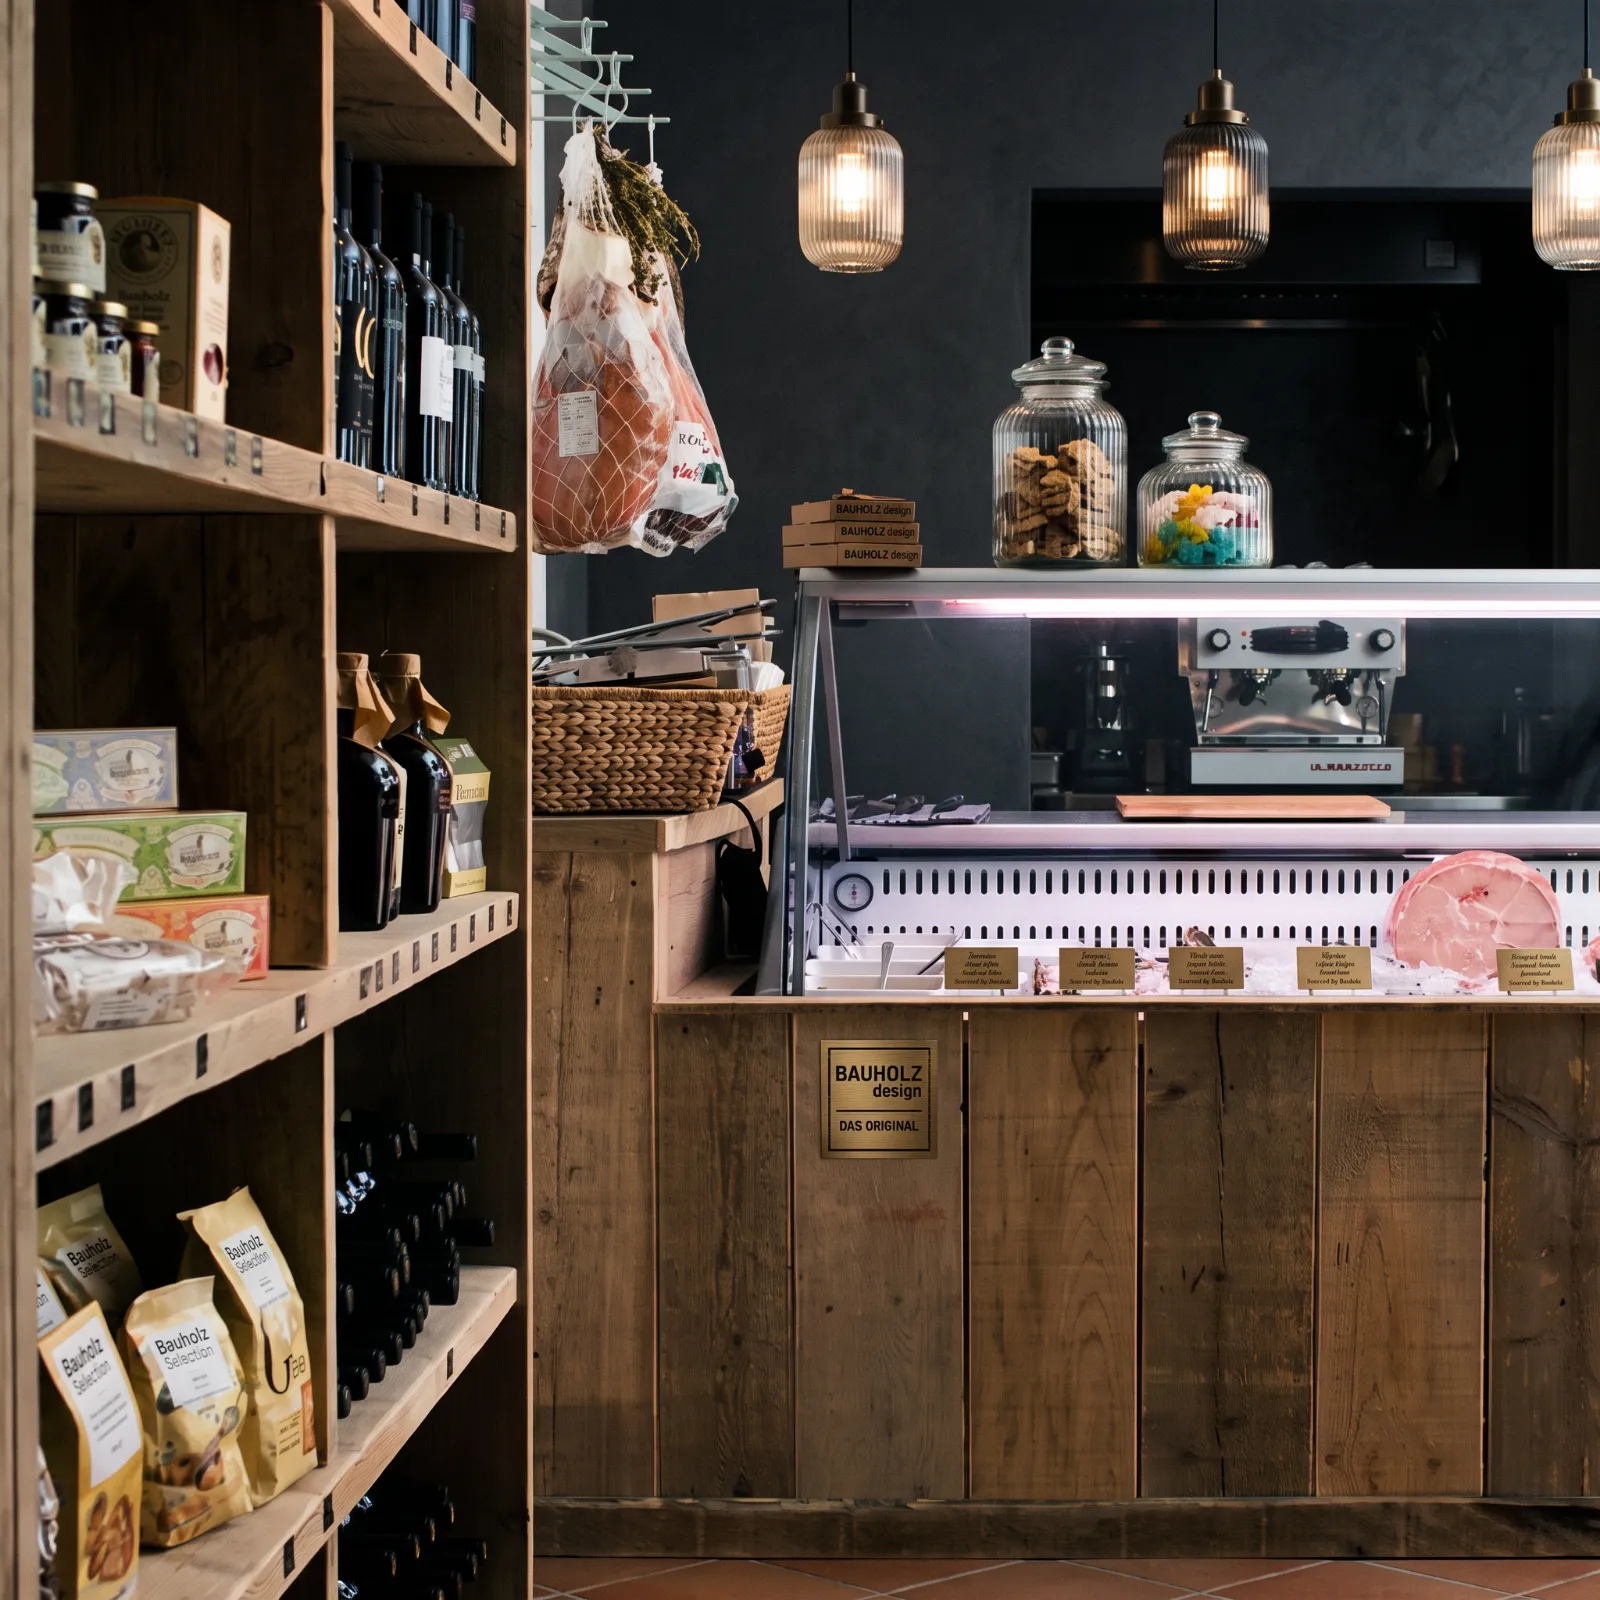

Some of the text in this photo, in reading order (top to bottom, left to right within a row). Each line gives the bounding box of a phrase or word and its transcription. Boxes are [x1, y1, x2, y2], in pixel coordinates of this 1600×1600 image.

[836, 504, 911, 517] BAUHOLZ design
[841, 527, 915, 538] BAUHOLZ design
[844, 550, 918, 561] BAUHOLZ design
[835, 1065, 922, 1081] BAUHOLZ
[873, 1084, 921, 1100] design
[839, 1120, 919, 1131] DAS ORIGINAL
[67, 1237, 112, 1266] Bauholz
[224, 1234, 264, 1261] Bauholz
[235, 1251, 271, 1274] Selection
[155, 1327, 210, 1355] Bauholz
[61, 1337, 104, 1378] Bauholz
[164, 1345, 215, 1370] Selection
[72, 1359, 112, 1395] Selection
